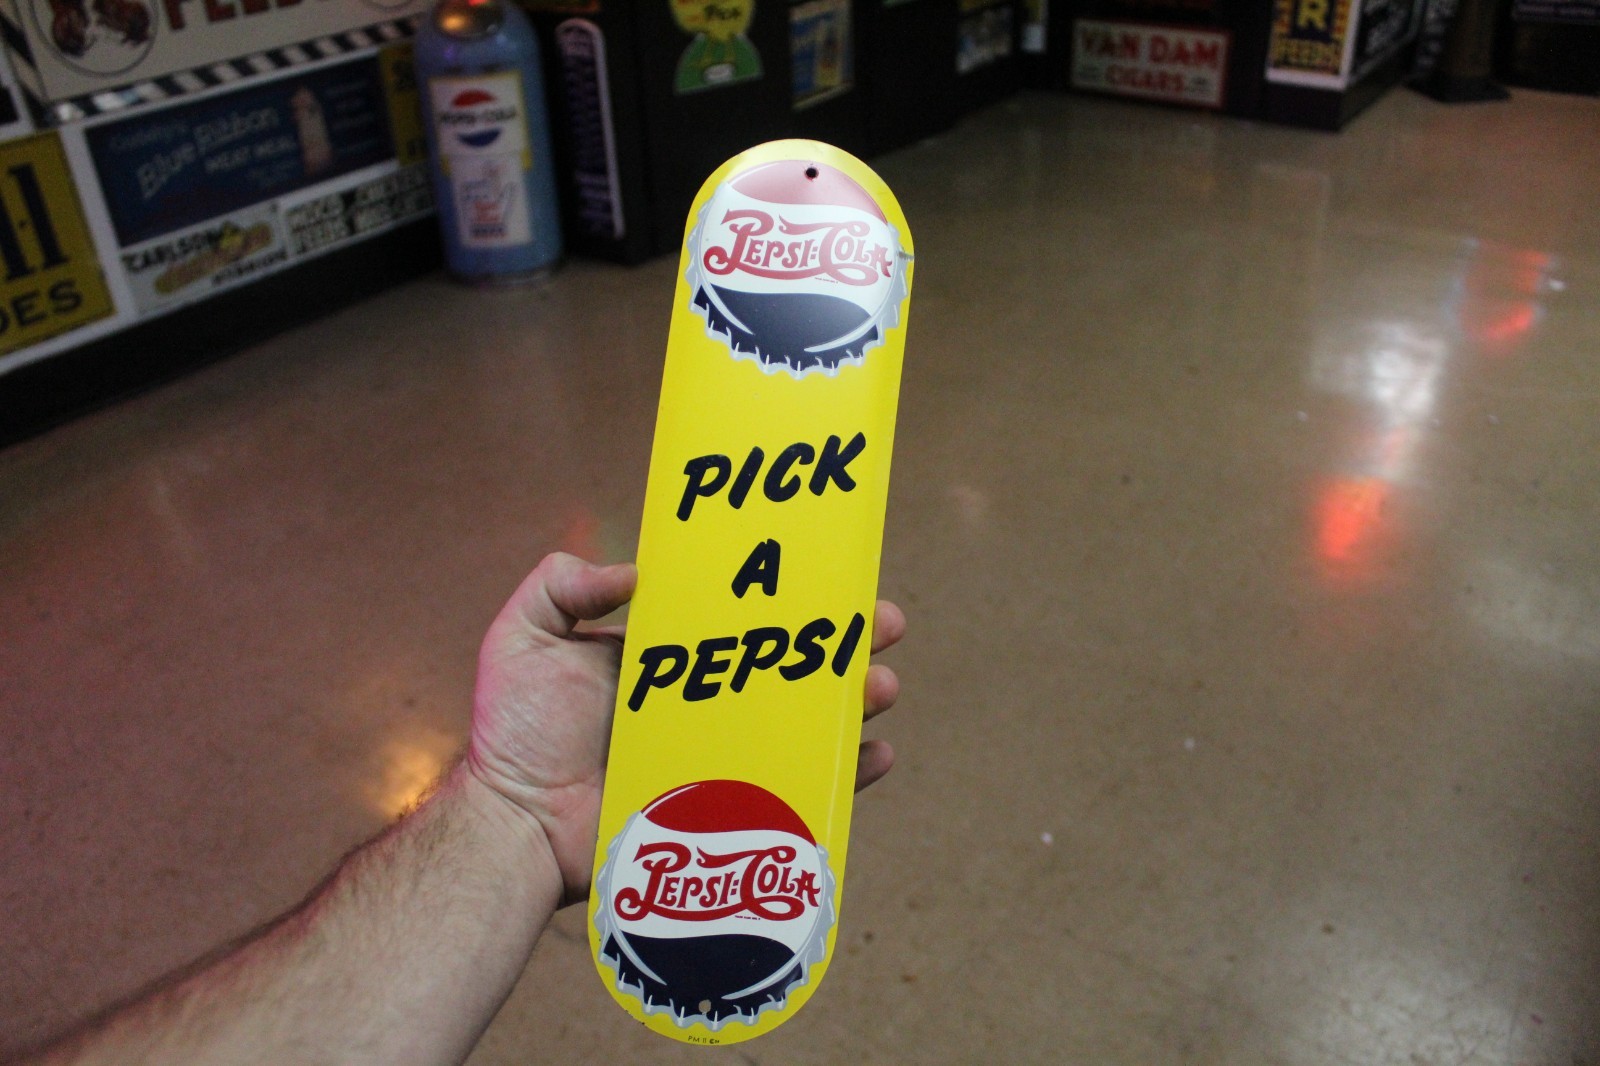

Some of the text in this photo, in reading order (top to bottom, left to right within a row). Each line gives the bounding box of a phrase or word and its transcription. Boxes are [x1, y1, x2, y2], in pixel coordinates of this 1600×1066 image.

[1081, 30, 1219, 65] VAN DAM
[1105, 64, 1185, 93] CIGARS
[676, 431, 867, 522] PICK
[731, 538, 781, 599] A
[627, 612, 866, 713] PEPSI
